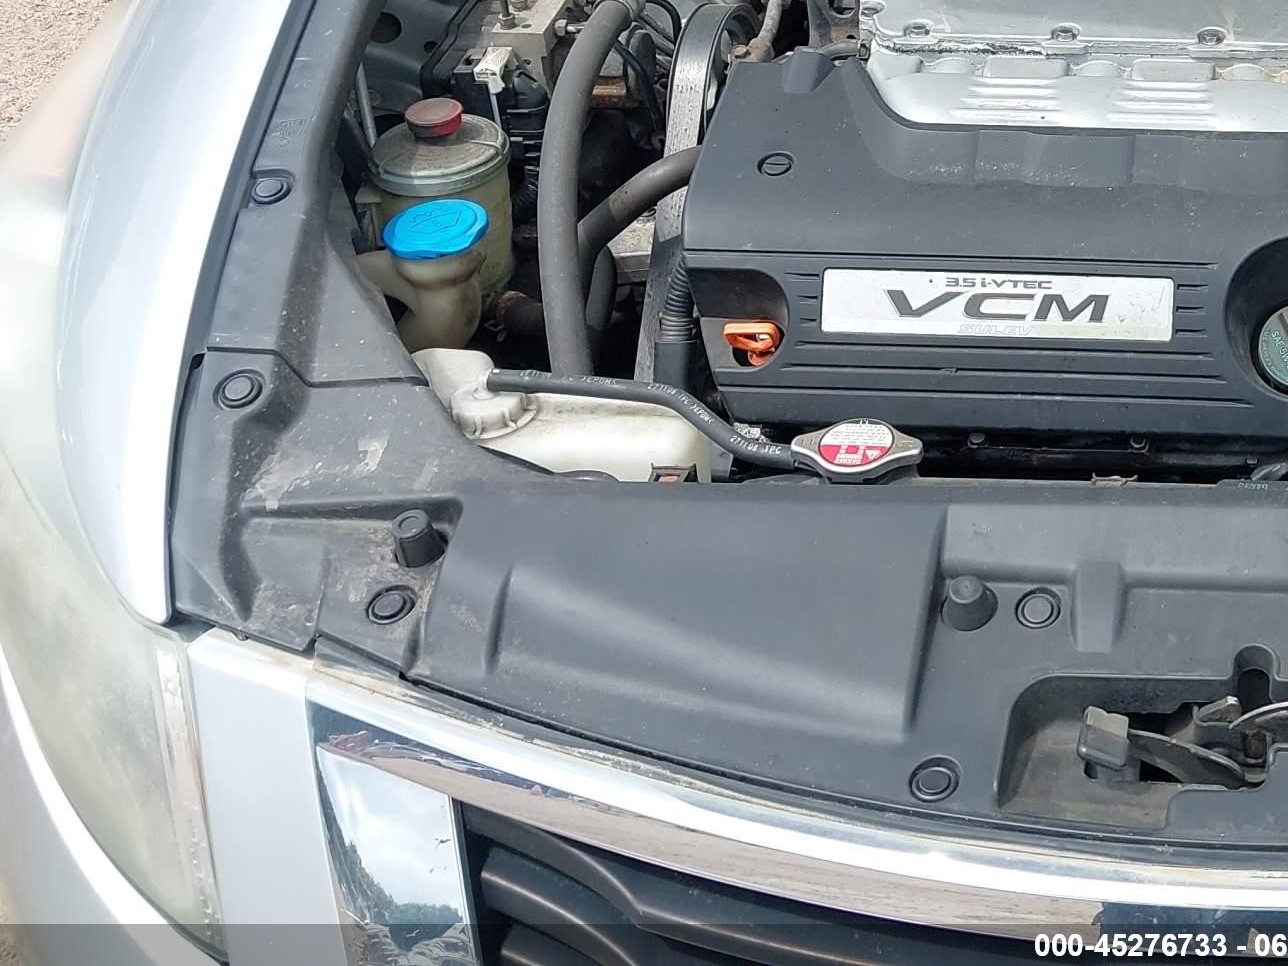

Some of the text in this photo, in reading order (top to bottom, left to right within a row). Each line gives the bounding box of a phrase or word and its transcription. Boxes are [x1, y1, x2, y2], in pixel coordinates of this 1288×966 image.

[945, 276, 1053, 290] 3.5 i-VTEC
[884, 288, 1111, 324] VCM
[957, 323, 1034, 337] SULEV
[1271, 330, 1285, 347] SAE
